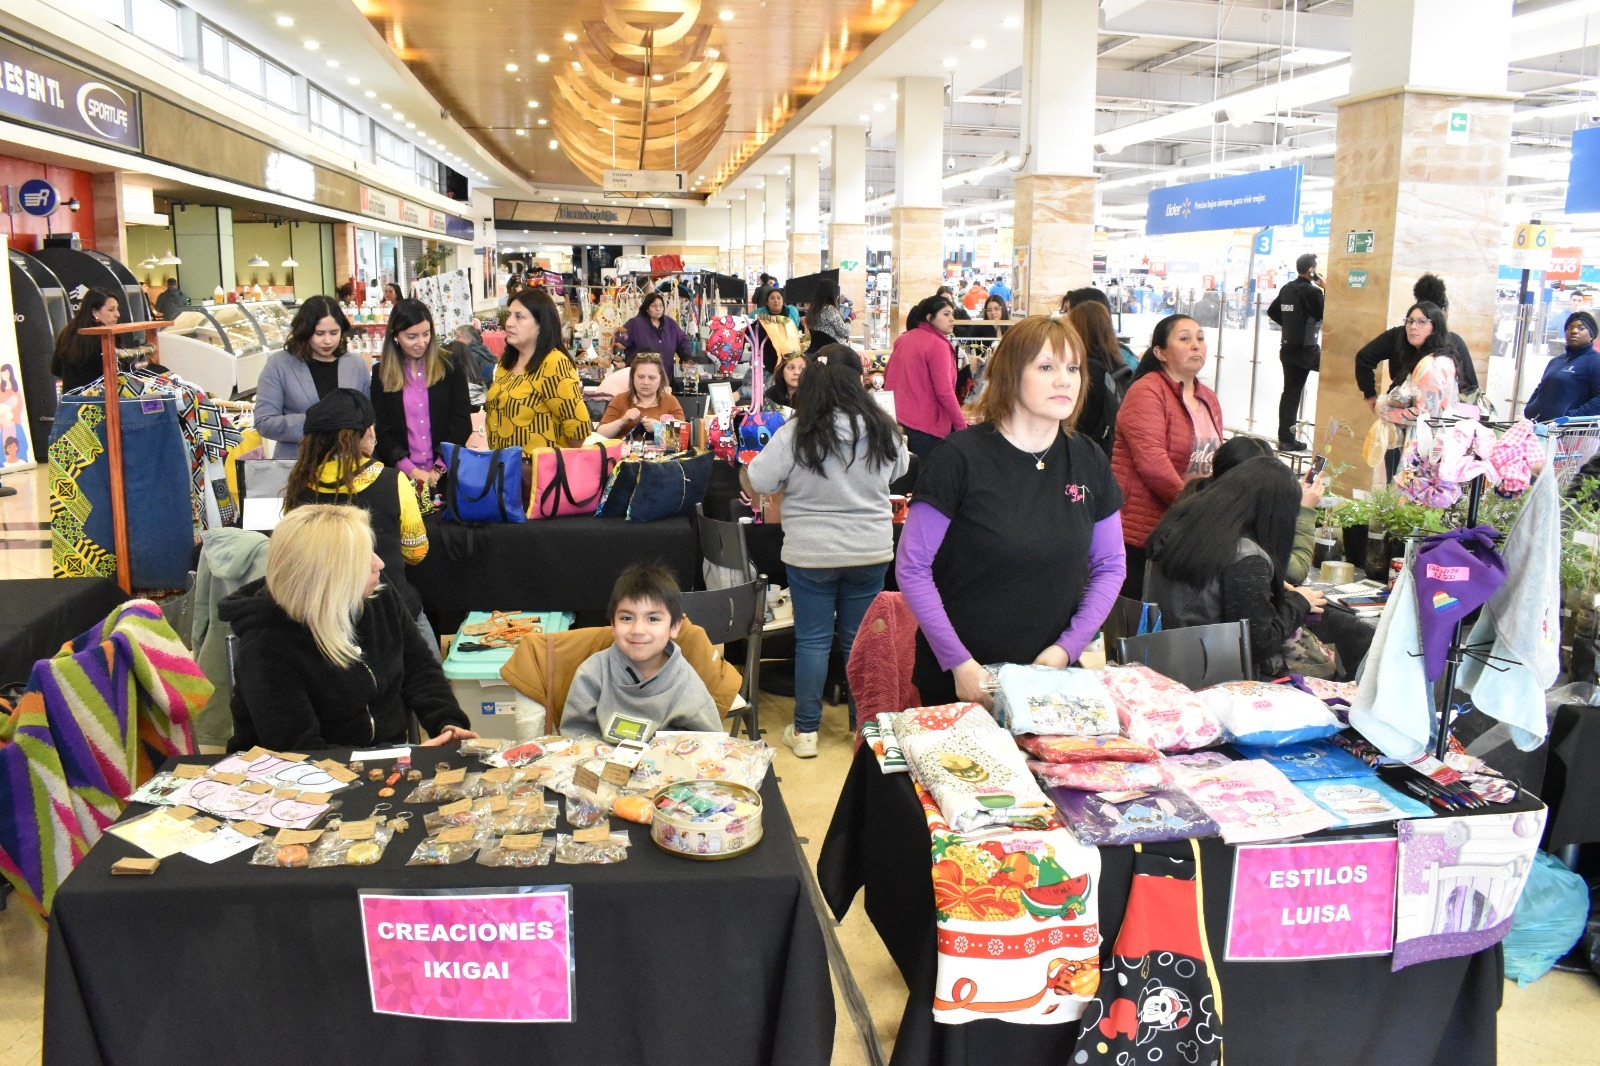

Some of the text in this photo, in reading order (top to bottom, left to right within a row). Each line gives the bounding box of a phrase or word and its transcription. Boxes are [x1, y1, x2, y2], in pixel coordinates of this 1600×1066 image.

[4, 61, 24, 96] ES
[25, 69, 46, 103] EN
[88, 98, 128, 128] SPORTLIFE
[676, 173, 683, 190] 1
[1260, 236, 1270, 252] 3
[1517, 228, 1526, 246] 6
[1536, 229, 1547, 247] 6
[1269, 865, 1368, 889] ESTILOS
[1281, 904, 1351, 926] LUISA
[377, 921, 554, 942] CREACIONES
[424, 961, 509, 980] IKIGAI
